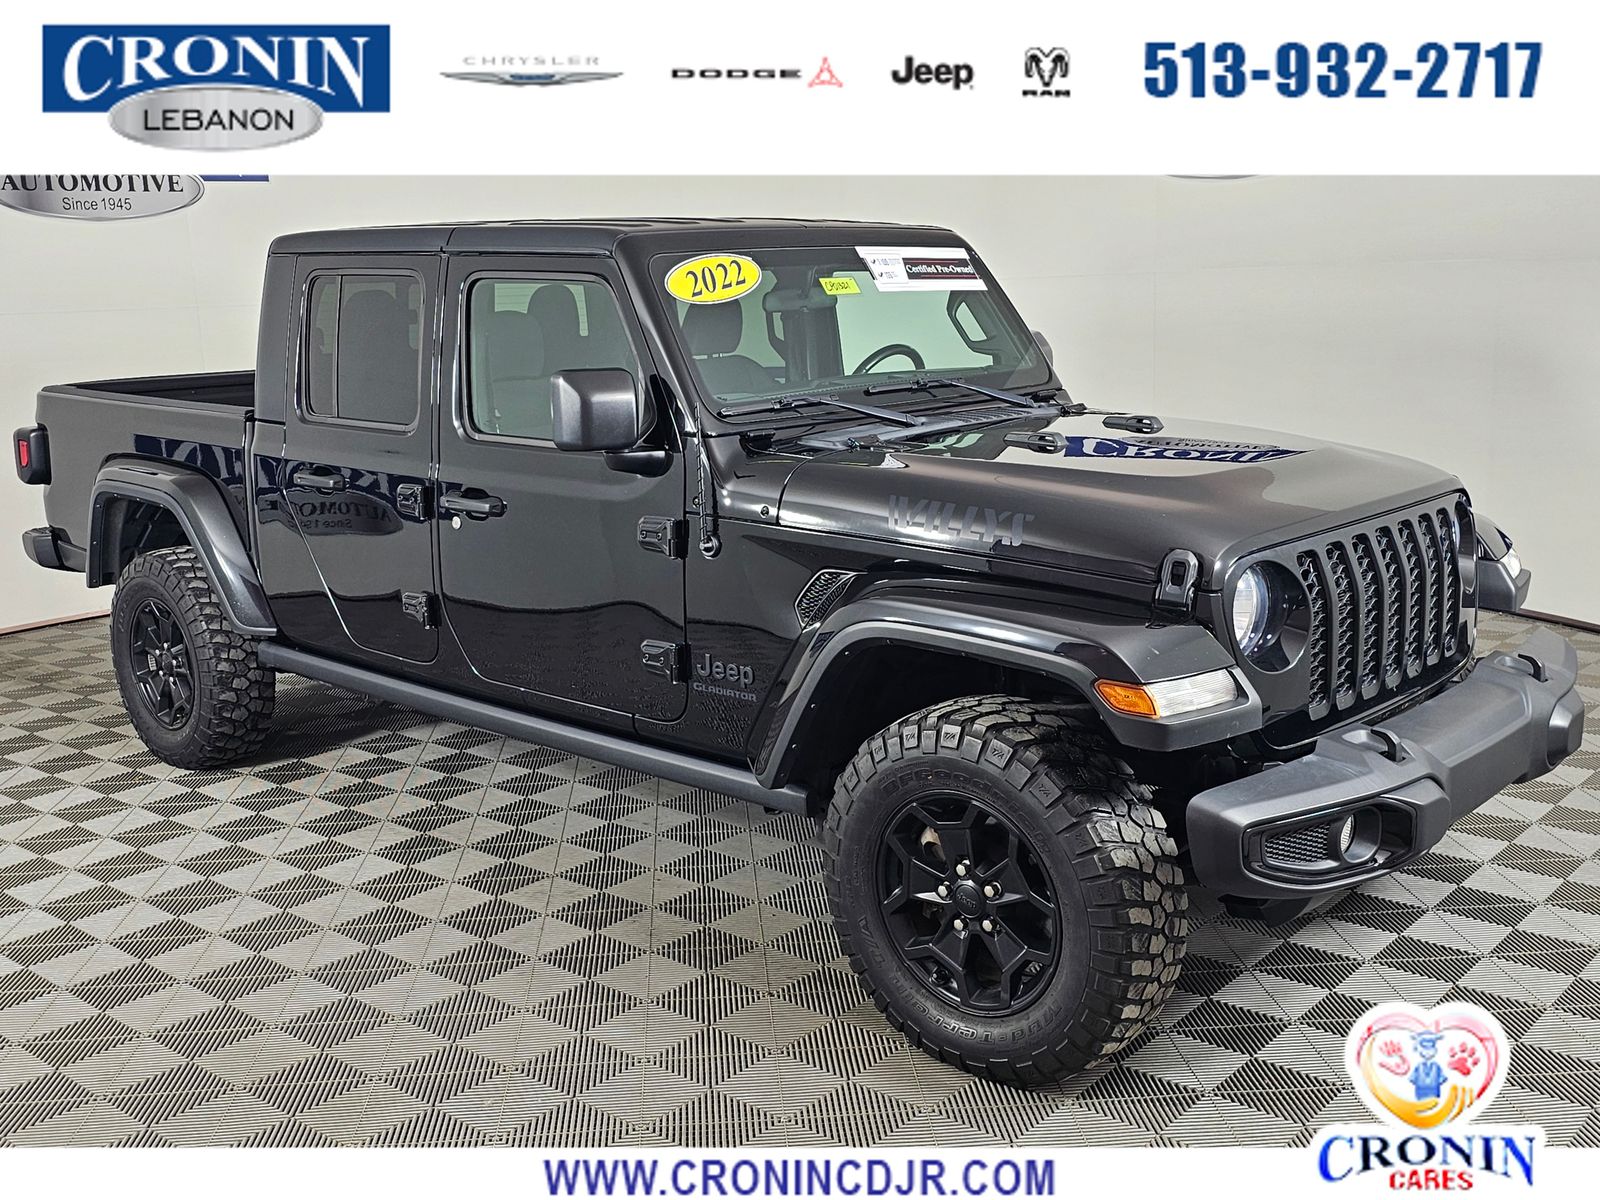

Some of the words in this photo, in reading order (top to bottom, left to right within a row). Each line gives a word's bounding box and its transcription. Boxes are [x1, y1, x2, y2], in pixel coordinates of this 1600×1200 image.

[1, 174, 184, 193] AUTOMOTIVE
[62, 196, 98, 211] Since
[101, 197, 132, 211] 1945
[685, 261, 747, 298] 2022
[906, 264, 936, 274] Certified
[937, 264, 975, 275] Pre-Owned
[696, 653, 755, 689] Jeep
[693, 681, 758, 702] GLADIATOR
